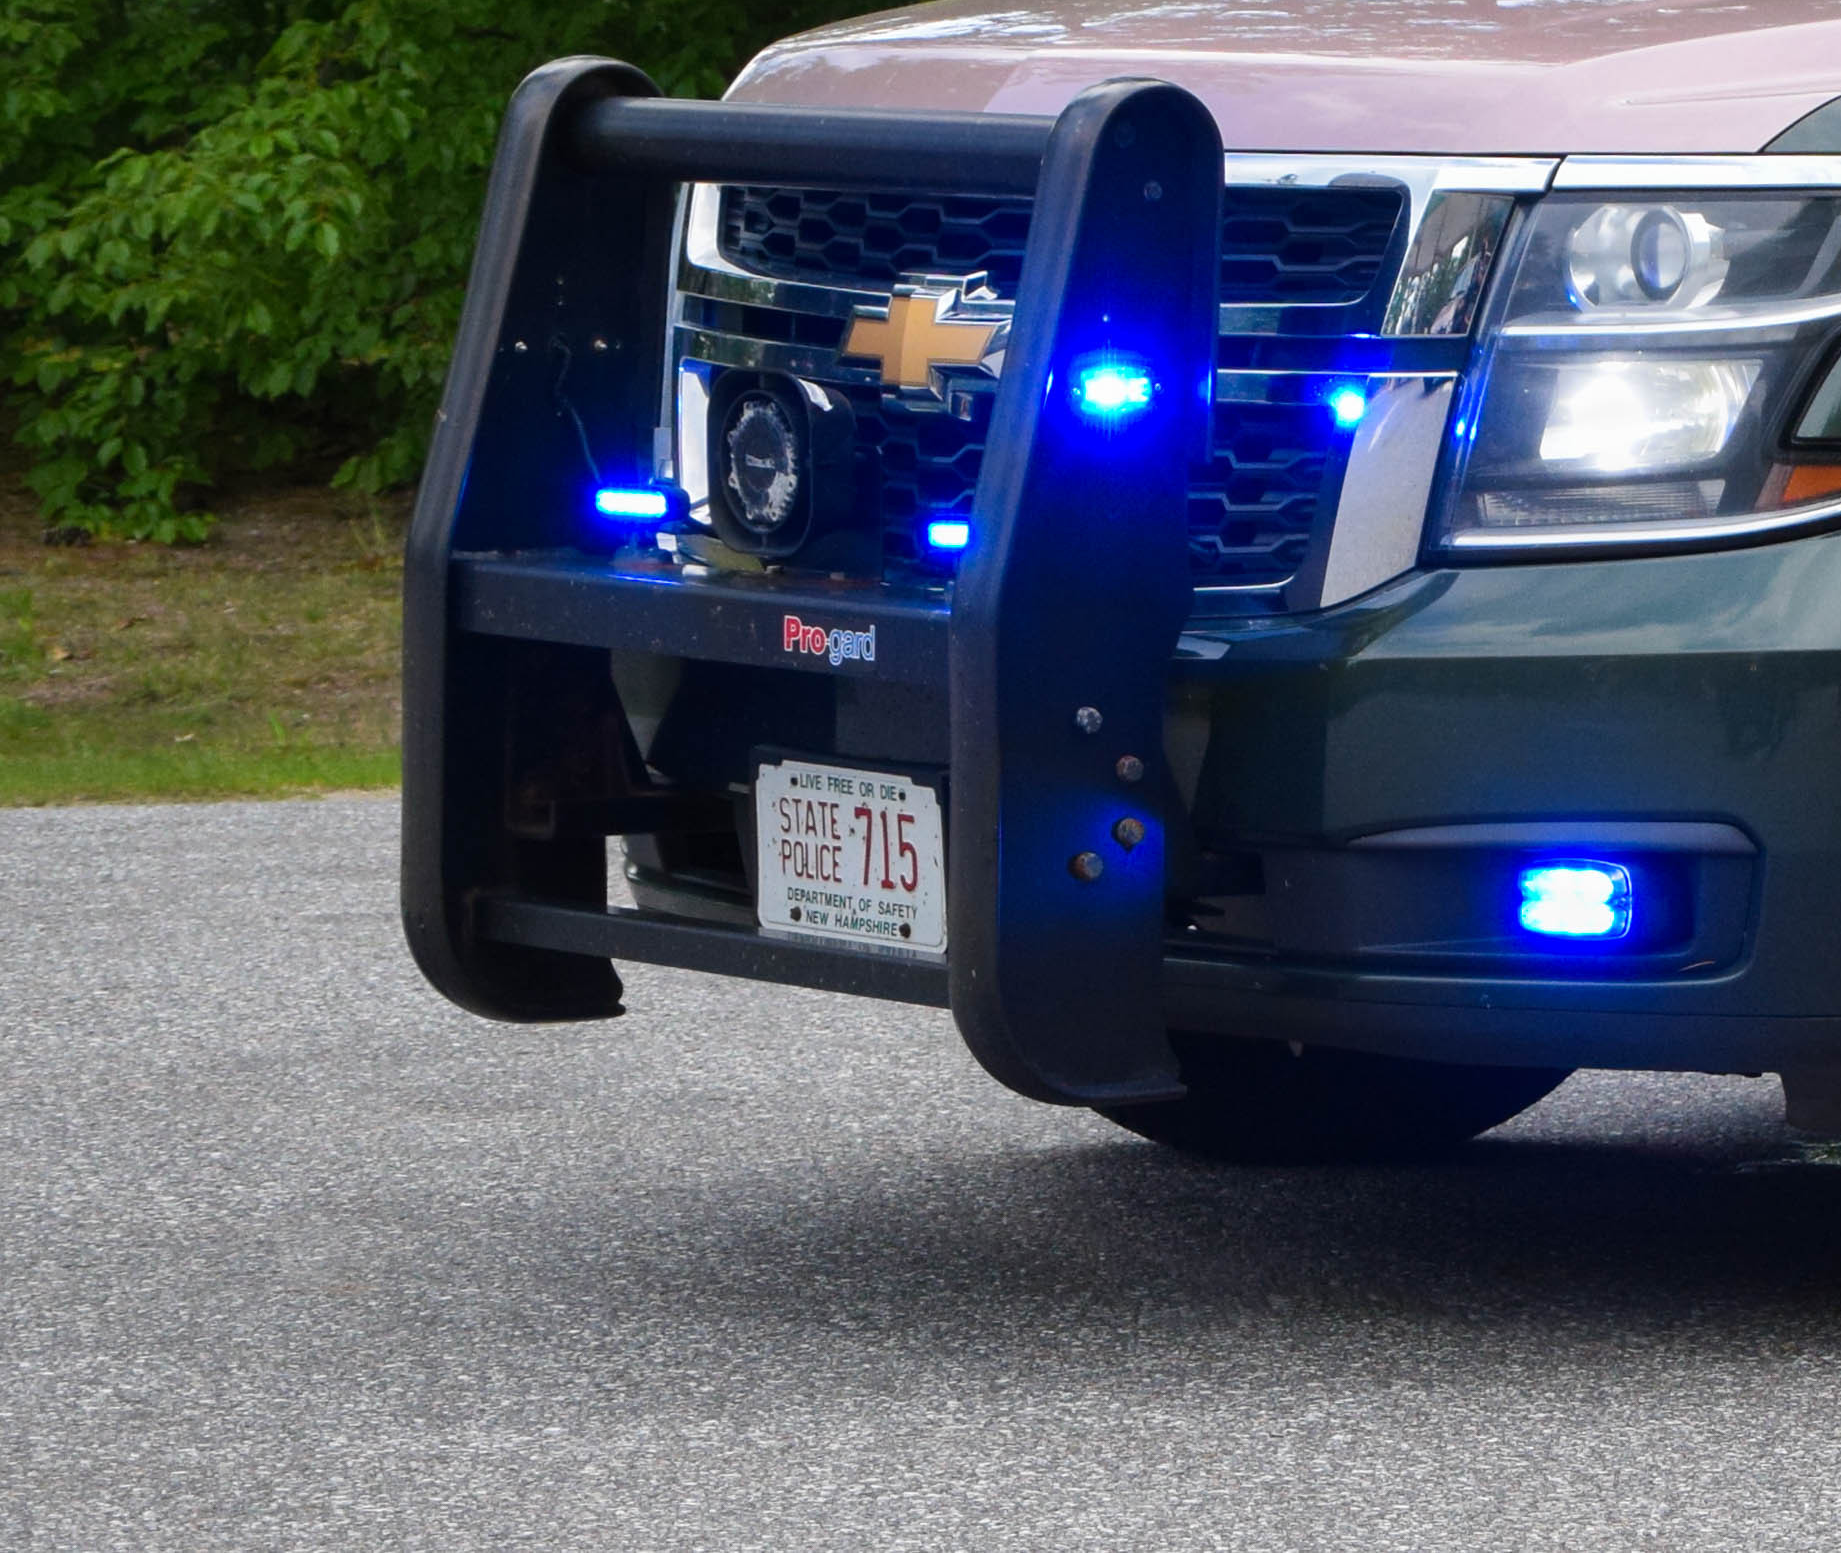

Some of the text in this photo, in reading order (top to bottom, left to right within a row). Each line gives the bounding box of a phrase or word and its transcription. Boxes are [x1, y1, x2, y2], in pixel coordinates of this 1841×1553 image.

[800, 773, 897, 801] LIVE FREE OR DIE
[779, 797, 841, 840] STATE
[781, 839, 842, 883] POLICE
[854, 807, 918, 893] 715
[787, 887, 918, 919] DEPARTMENT OF SAFETY
[806, 909, 898, 936] NEW HAMPSHIRE
